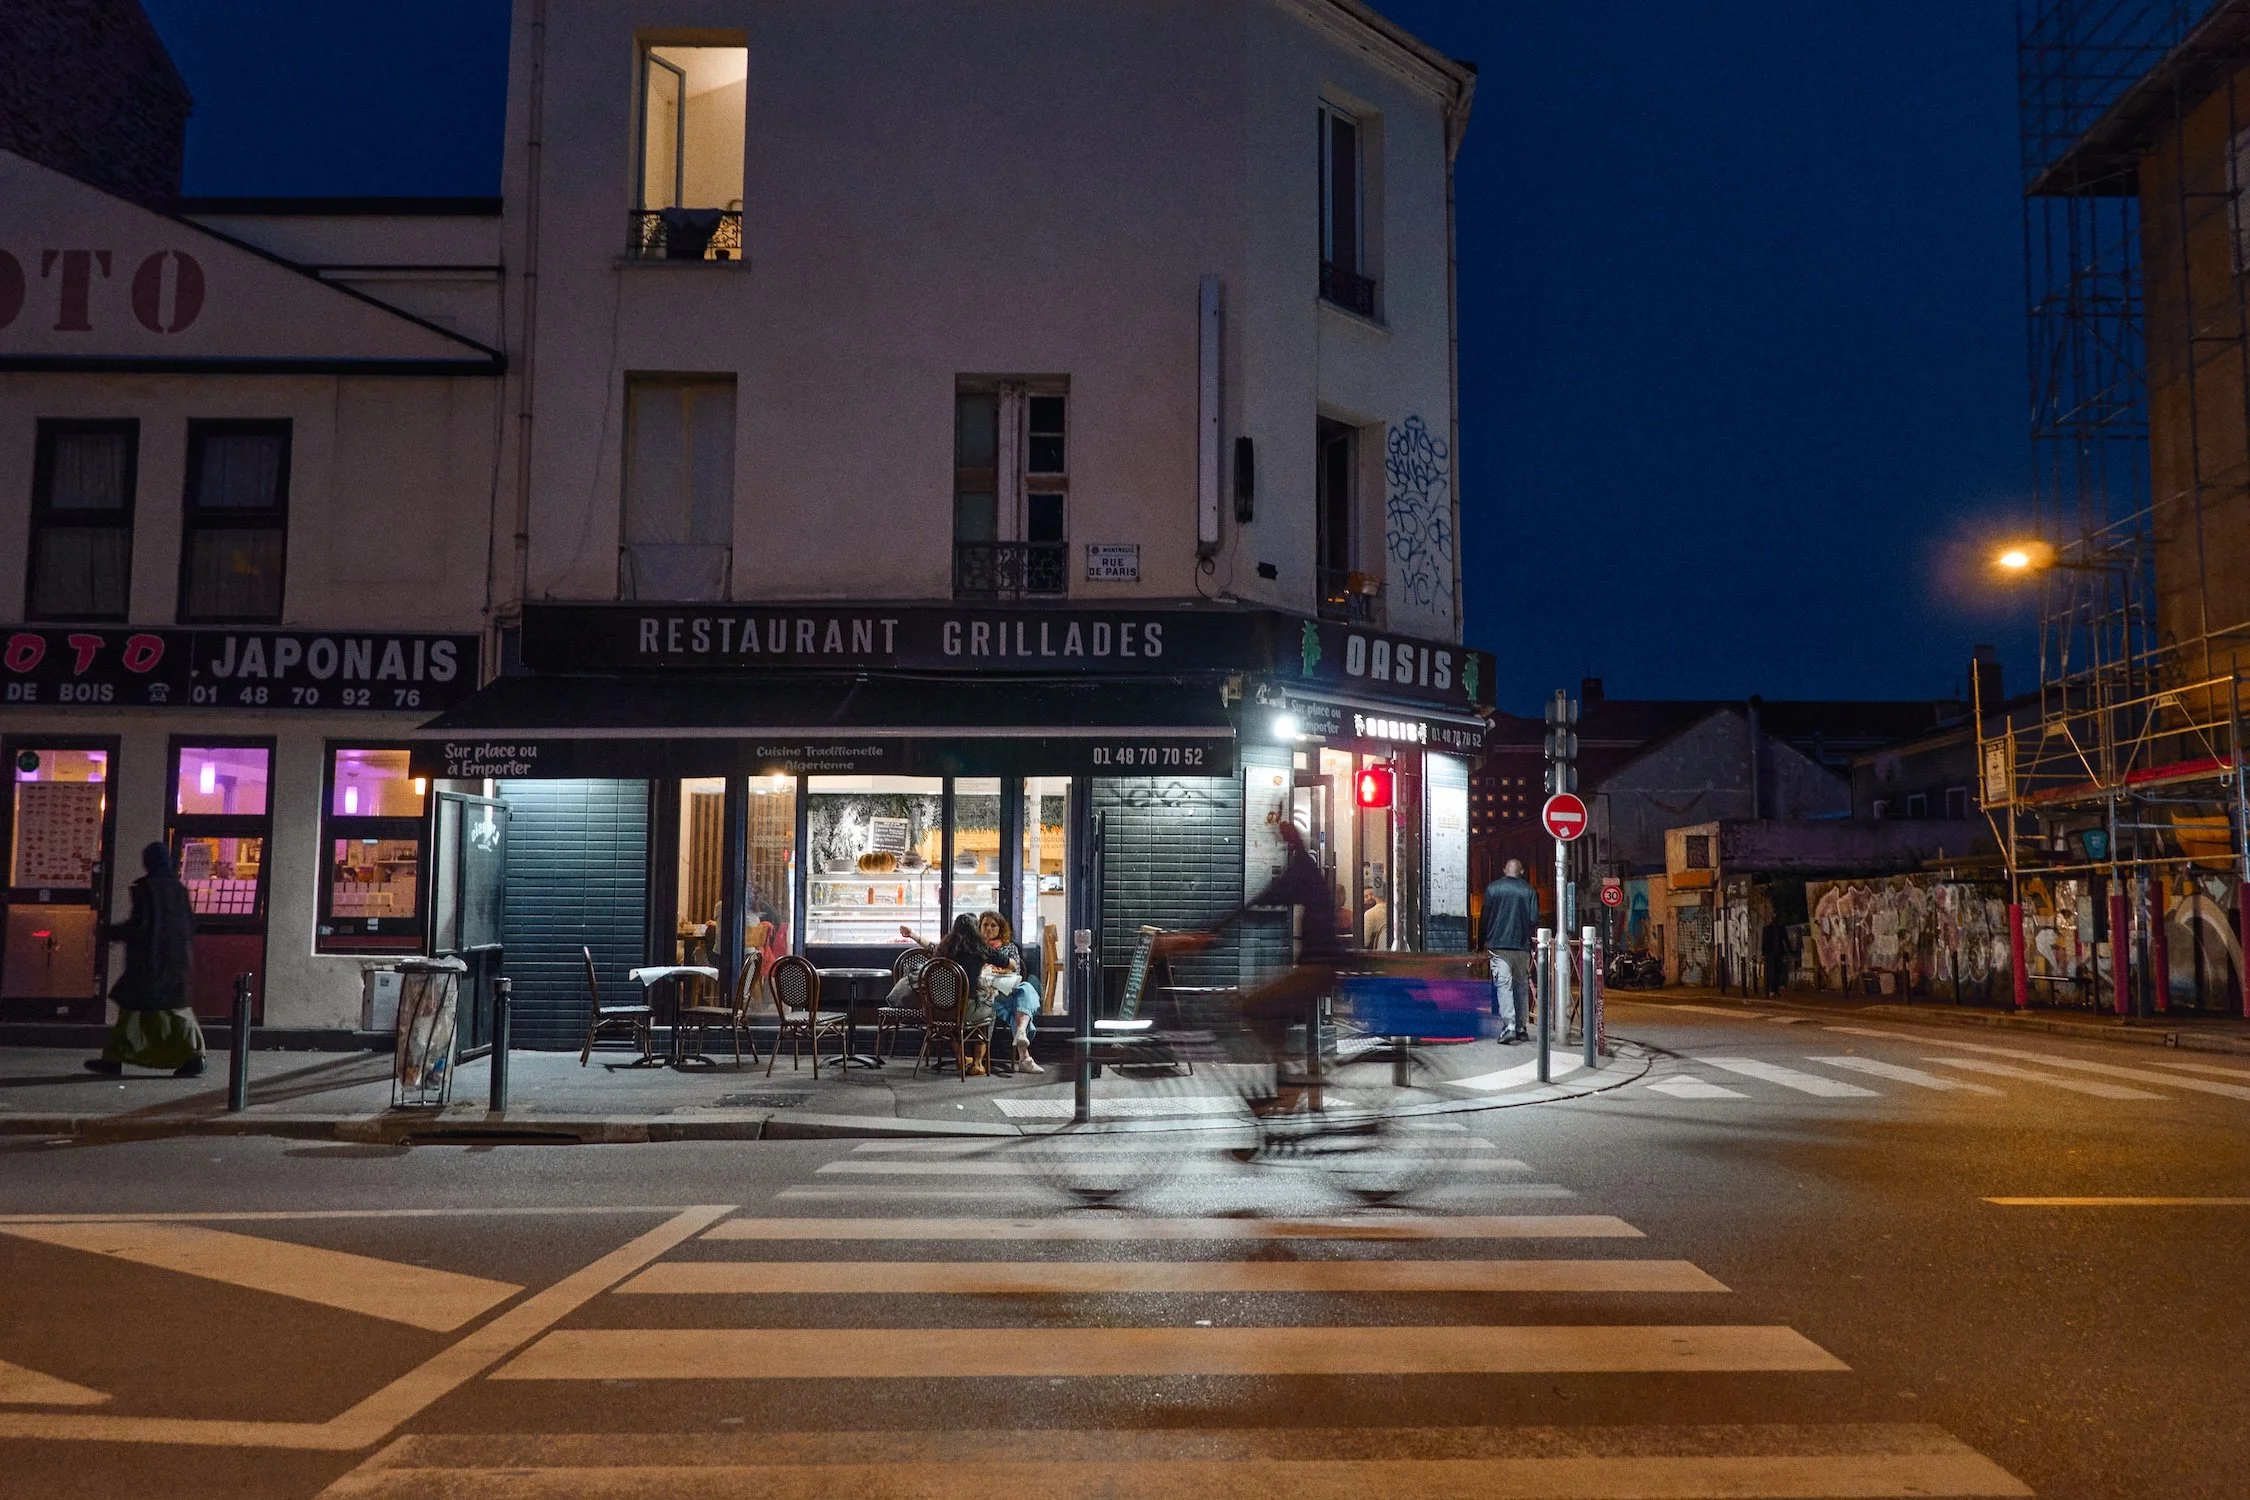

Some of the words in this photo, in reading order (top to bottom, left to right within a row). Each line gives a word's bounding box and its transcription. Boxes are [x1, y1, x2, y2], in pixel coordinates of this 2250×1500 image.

[1102, 558, 1124, 566] RUE
[1089, 567, 1101, 576] DE
[1106, 567, 1137, 577] PARIS
[639, 618, 898, 654] RESTAURANT
[943, 620, 1164, 657] GRILLADES
[211, 636, 458, 682] JAPONAIS
[1345, 634, 1451, 690] OASIS
[7, 683, 37, 700] DE
[60, 683, 114, 701] BOIS
[192, 686, 218, 704] 01
[239, 687, 269, 705] 48
[291, 687, 320, 705] 70
[342, 688, 370, 706] 92
[393, 689, 420, 707] 76
[1291, 699, 1305, 713] Sur
[1308, 702, 1330, 718] place
[1331, 709, 1342, 719] ou
[1431, 727, 1441, 742] 01
[1442, 728, 1451, 744] 48
[1452, 730, 1461, 745] 70
[1462, 731, 1471, 746] 70
[1472, 733, 1482, 747] 52
[445, 743, 471, 759] Sur
[475, 743, 516, 762] place
[519, 746, 537, 758] ou
[756, 746, 801, 757] Cuisine
[1093, 748, 1111, 765] 01
[1116, 748, 1134, 765] 48
[1139, 748, 1157, 765] 70
[1162, 748, 1180, 765] 70
[1184, 748, 1203, 765] 52
[447, 760, 458, 776] à
[462, 759, 531, 778] Emporter
[1606, 891, 1618, 901] 30
